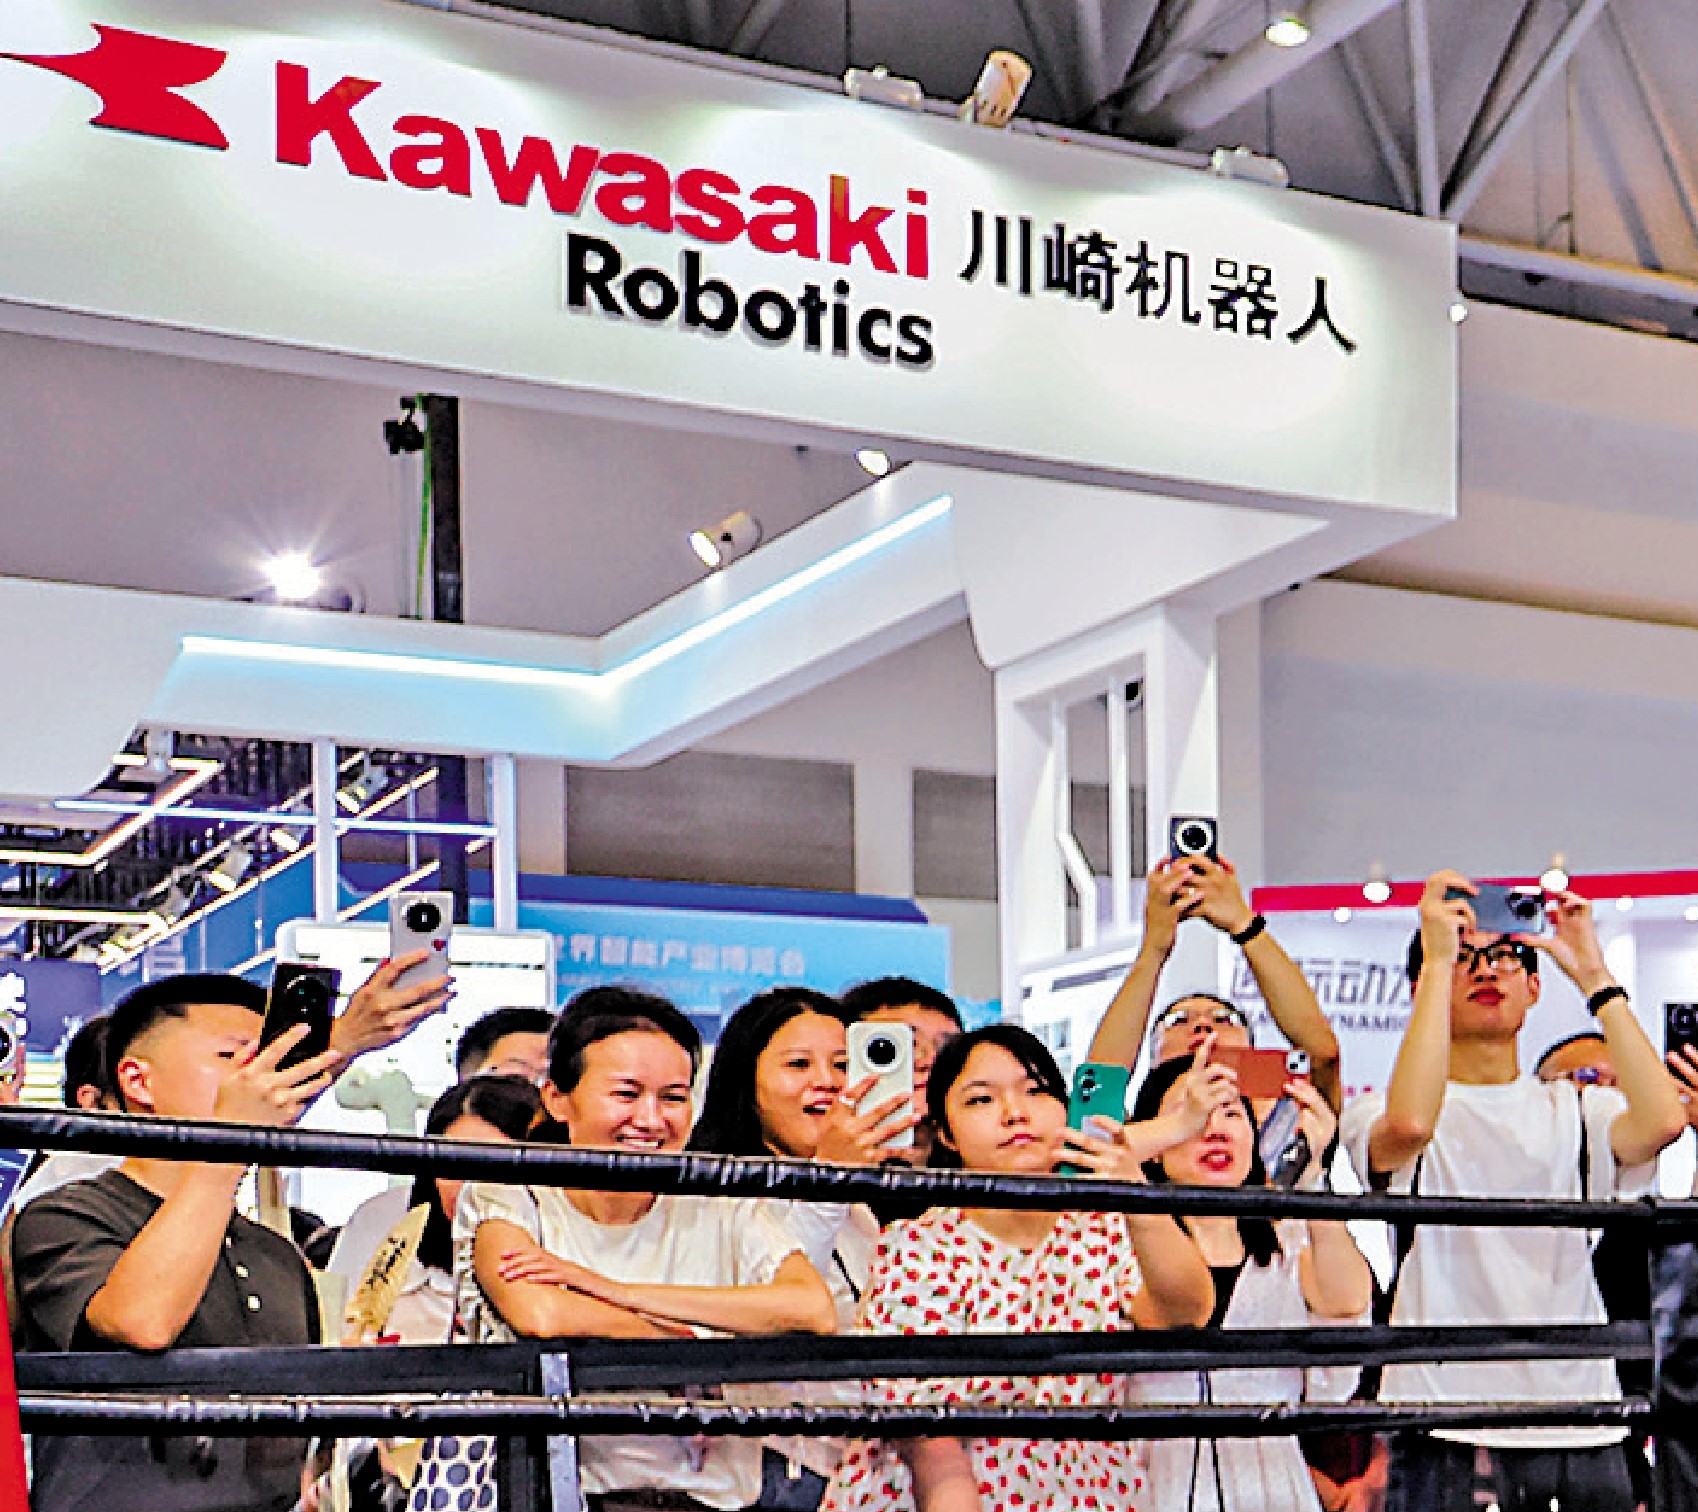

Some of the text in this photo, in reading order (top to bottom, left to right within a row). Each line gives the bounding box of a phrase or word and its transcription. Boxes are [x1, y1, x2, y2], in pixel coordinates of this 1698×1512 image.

[276, 60, 929, 279] Kawasaki
[567, 234, 933, 367] Robotics
[960, 209, 1357, 354] 川崎机器人
